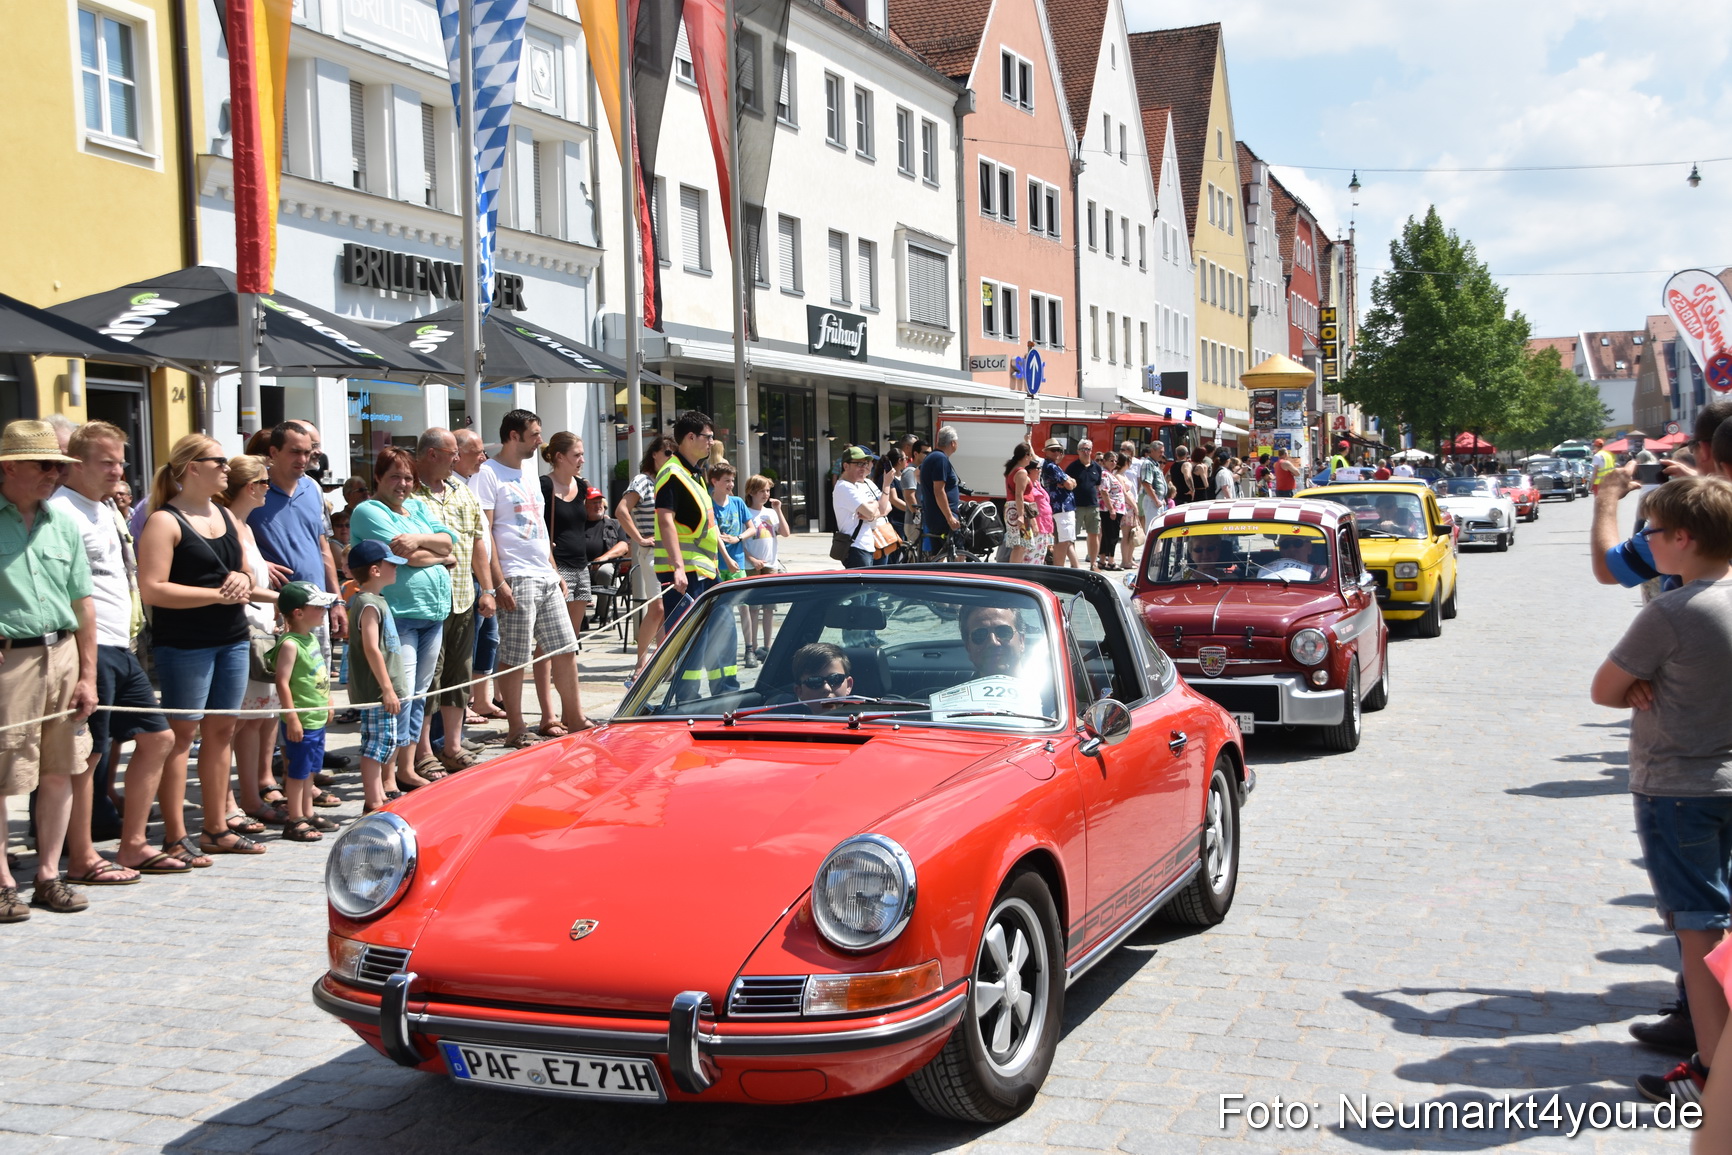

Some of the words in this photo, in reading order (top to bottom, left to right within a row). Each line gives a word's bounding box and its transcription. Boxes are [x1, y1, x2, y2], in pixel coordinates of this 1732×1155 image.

[344, 243, 446, 299] BRILLEN
[811, 312, 867, 356] frühauf
[1321, 308, 1337, 392] HOTE
[172, 386, 187, 404] 24
[1085, 856, 1176, 932] PORSCHE
[461, 1049, 521, 1080] PAF
